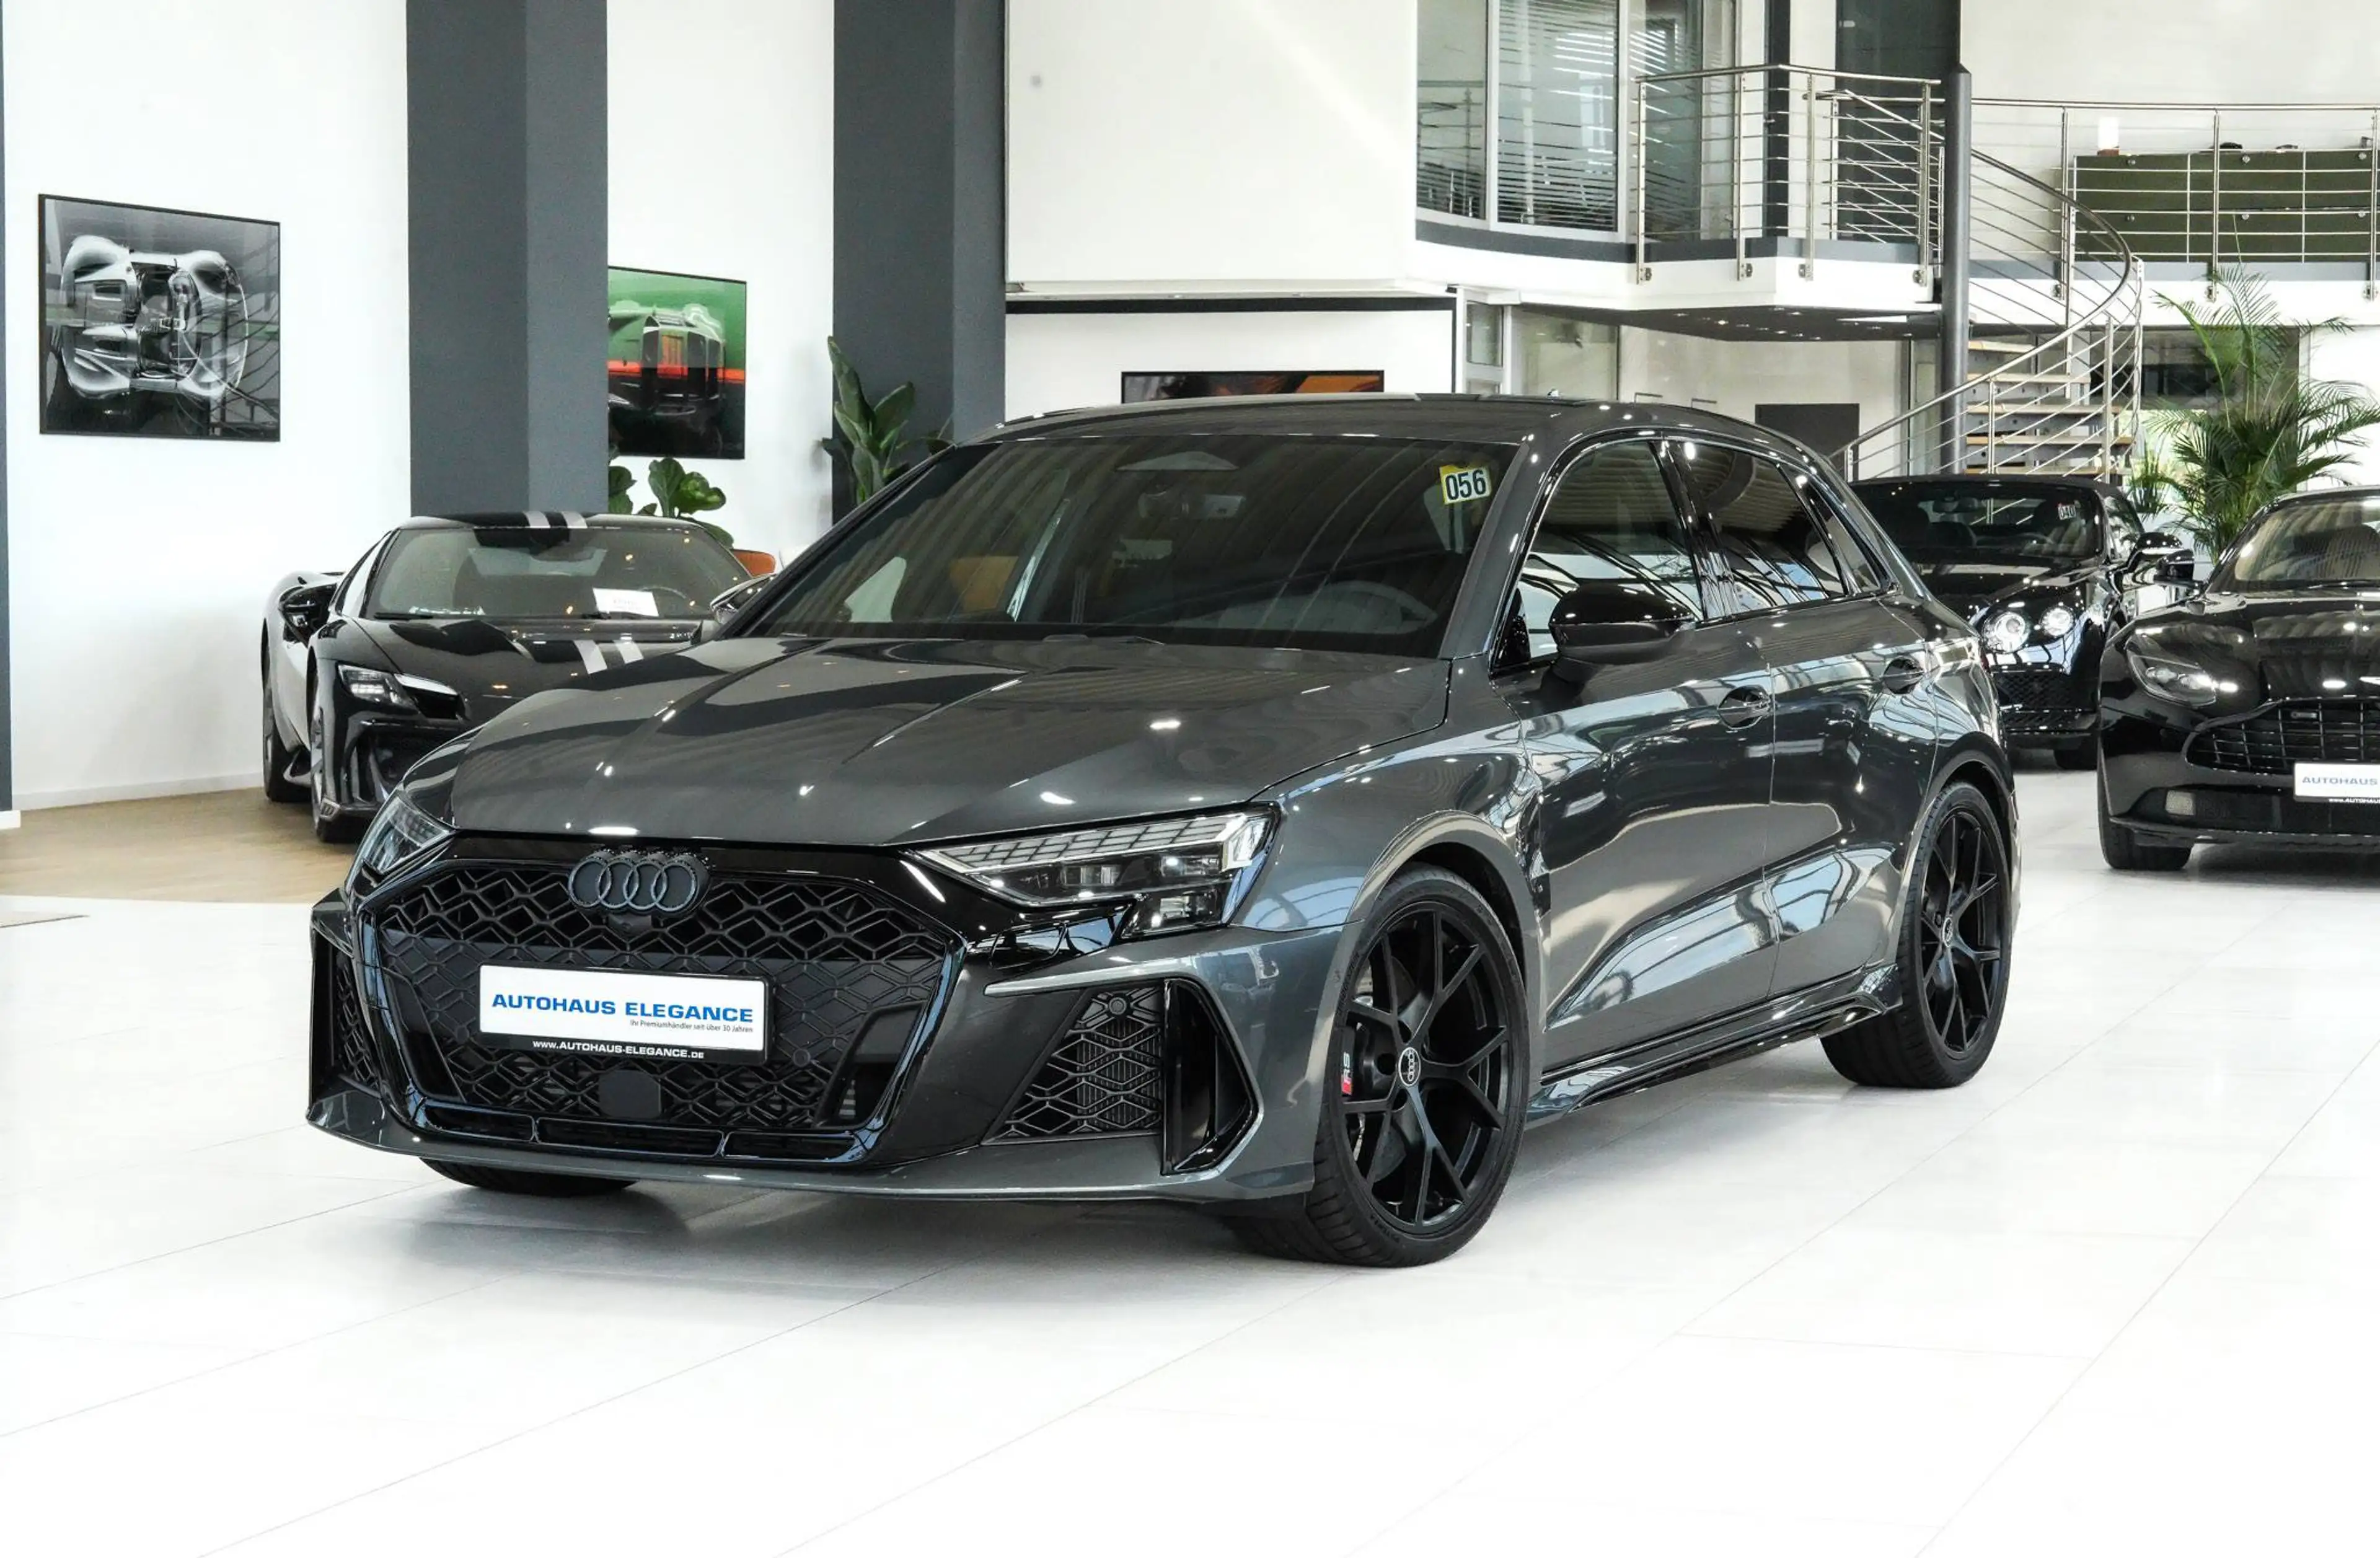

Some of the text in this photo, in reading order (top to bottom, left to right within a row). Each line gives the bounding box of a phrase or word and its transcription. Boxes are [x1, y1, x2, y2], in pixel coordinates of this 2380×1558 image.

[1445, 469, 1486, 500] 056
[2302, 777, 2378, 785] AUTOHAUS
[492, 994, 753, 1023] AUTOHAUS ELEGANCE
[640, 1019, 692, 1030] Premiumhändler
[532, 1041, 704, 1058] www.AUTOHAUS-ELEGANCE.DE
